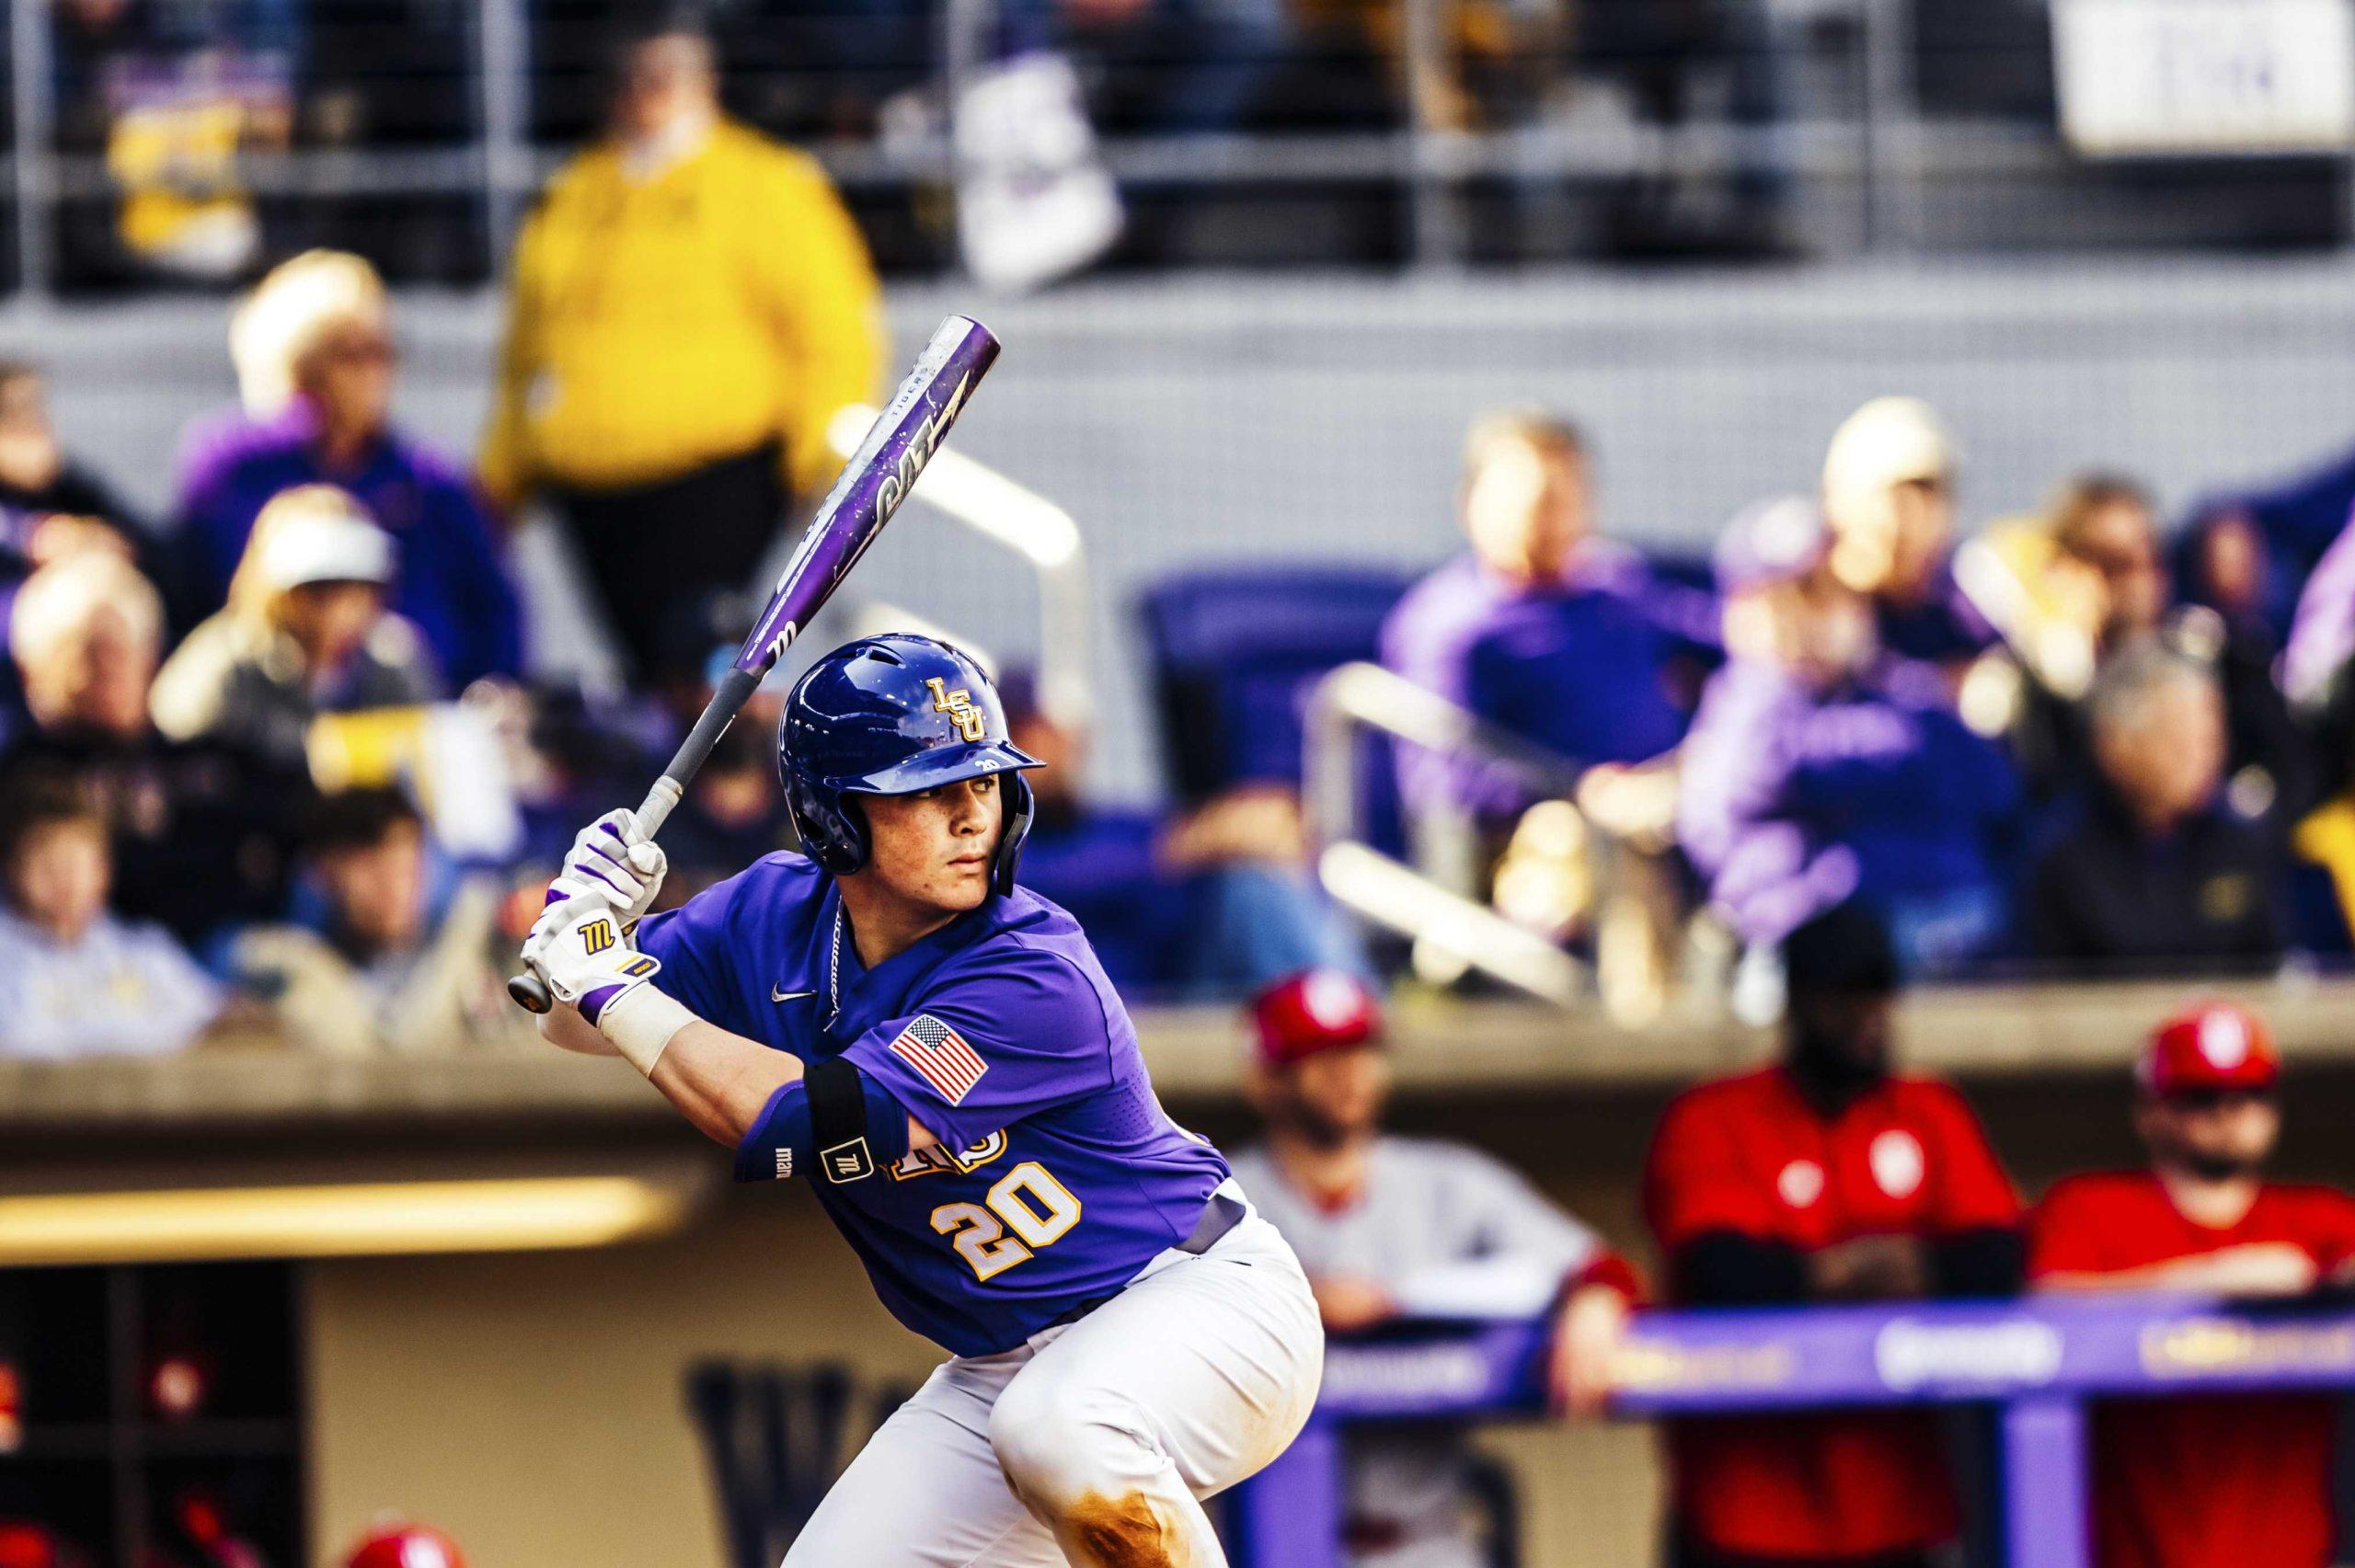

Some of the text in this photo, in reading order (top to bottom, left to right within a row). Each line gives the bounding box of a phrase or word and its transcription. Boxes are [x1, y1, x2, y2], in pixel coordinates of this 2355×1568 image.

[926, 677, 985, 742] LSU
[975, 759, 1001, 773] 20
[930, 1161, 1082, 1282] 20
